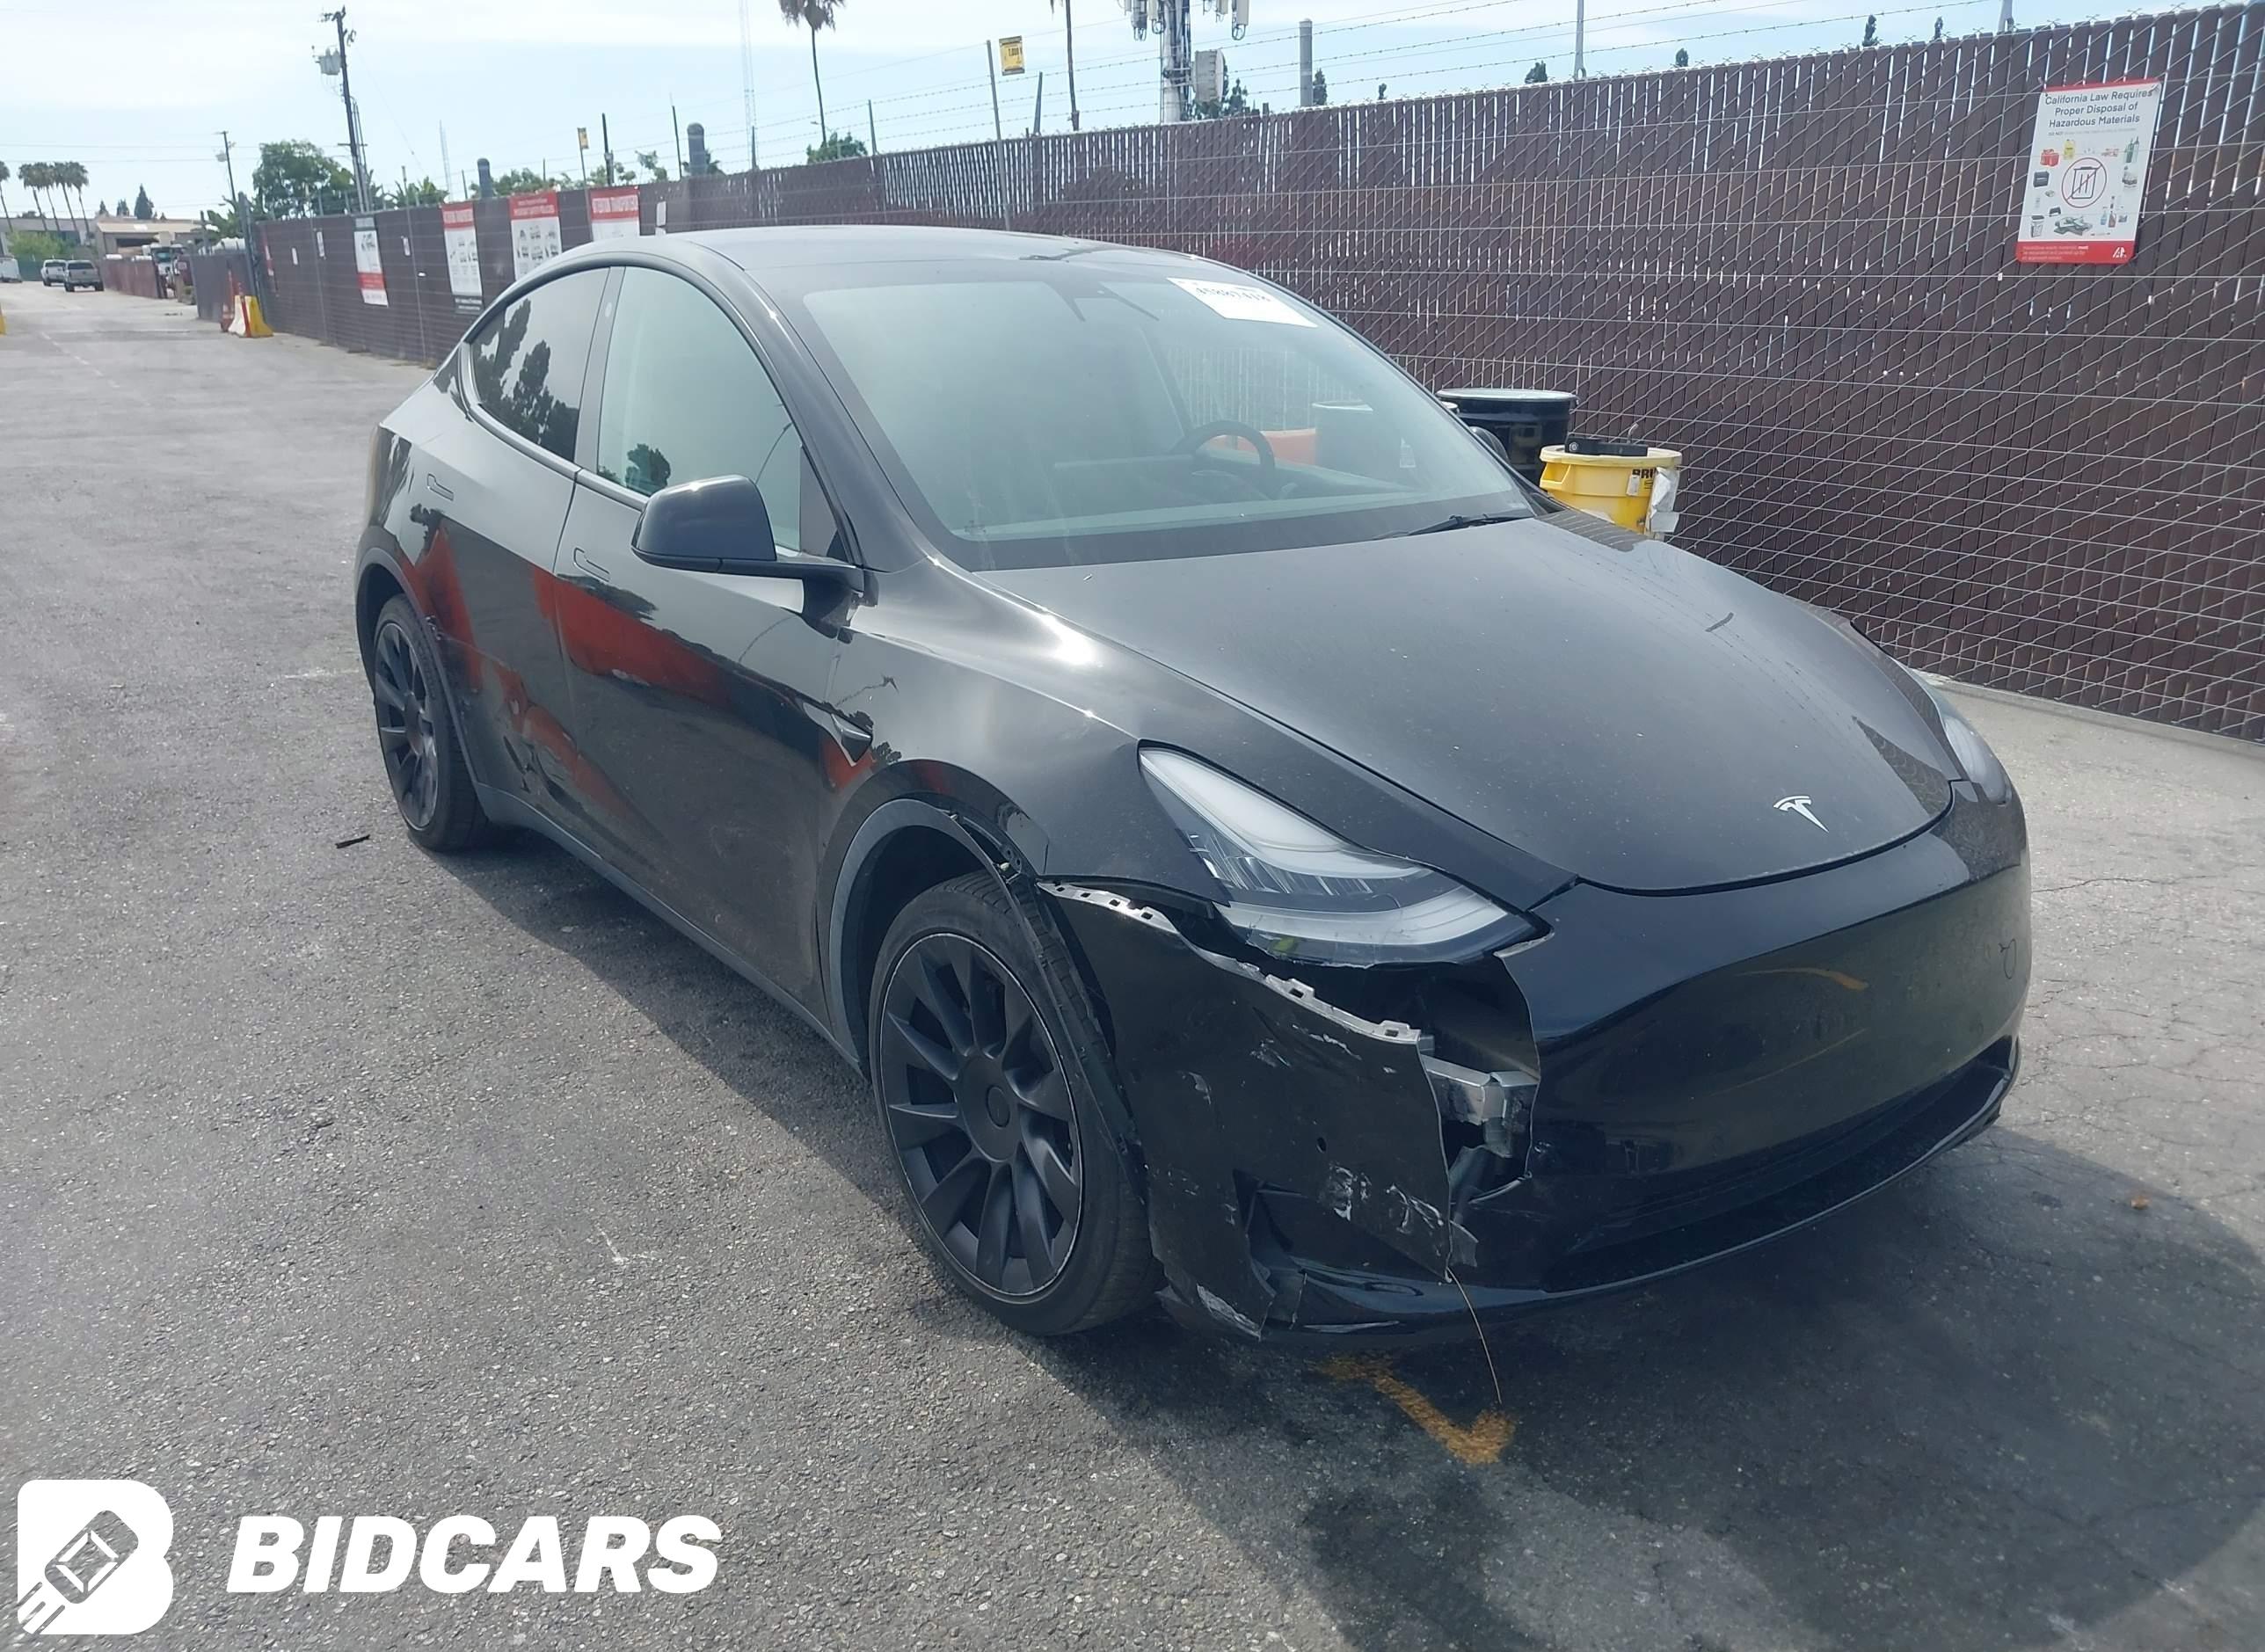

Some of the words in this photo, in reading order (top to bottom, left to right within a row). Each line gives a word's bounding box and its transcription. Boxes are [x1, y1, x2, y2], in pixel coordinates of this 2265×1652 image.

[2045, 93, 2087, 105] California
[2090, 93, 2108, 102] Law
[2111, 89, 2152, 100] Requires
[2055, 106, 2085, 116] Proper
[2087, 102, 2126, 114] Disposal
[2128, 101, 2138, 111] of
[2049, 117, 2096, 127] Hazardous
[2099, 114, 2140, 125] Materials
